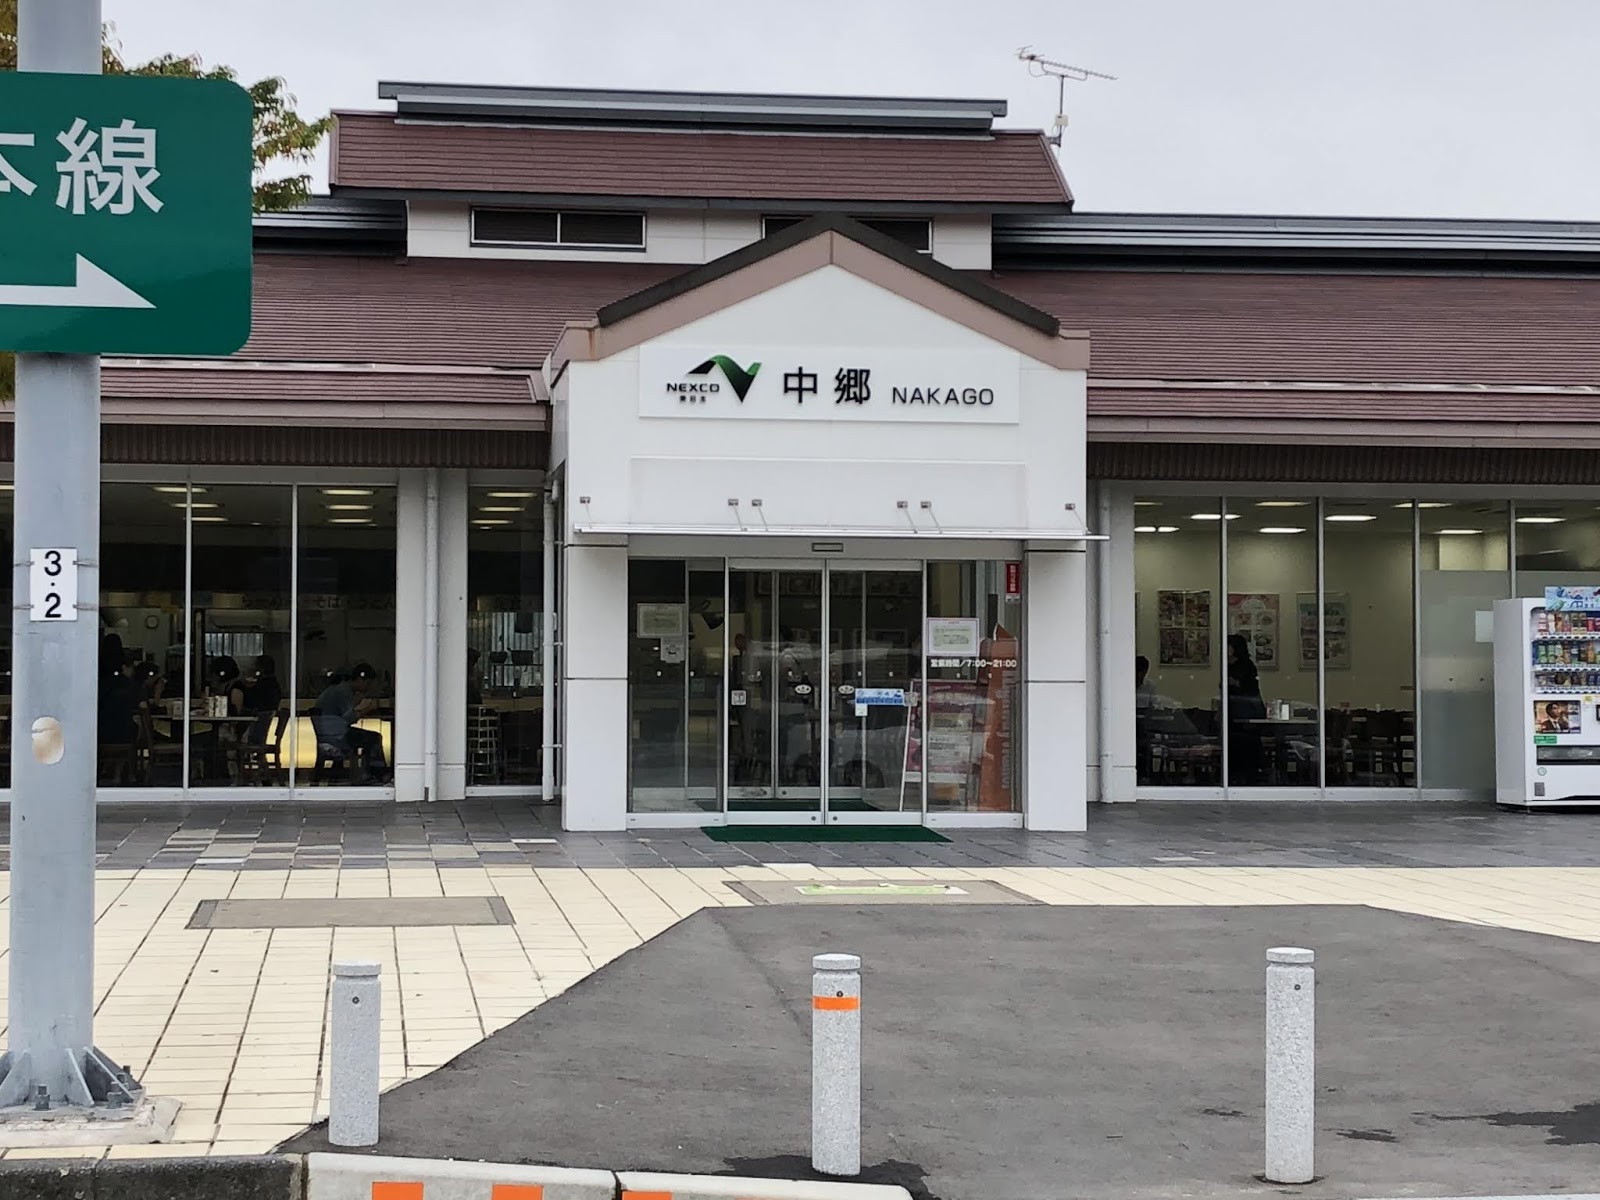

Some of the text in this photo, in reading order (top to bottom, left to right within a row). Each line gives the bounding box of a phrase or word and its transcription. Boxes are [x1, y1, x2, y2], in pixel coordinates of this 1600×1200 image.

[667, 383, 720, 393] NEXCO
[783, 366, 994, 405] 中郷 NAKAGO
